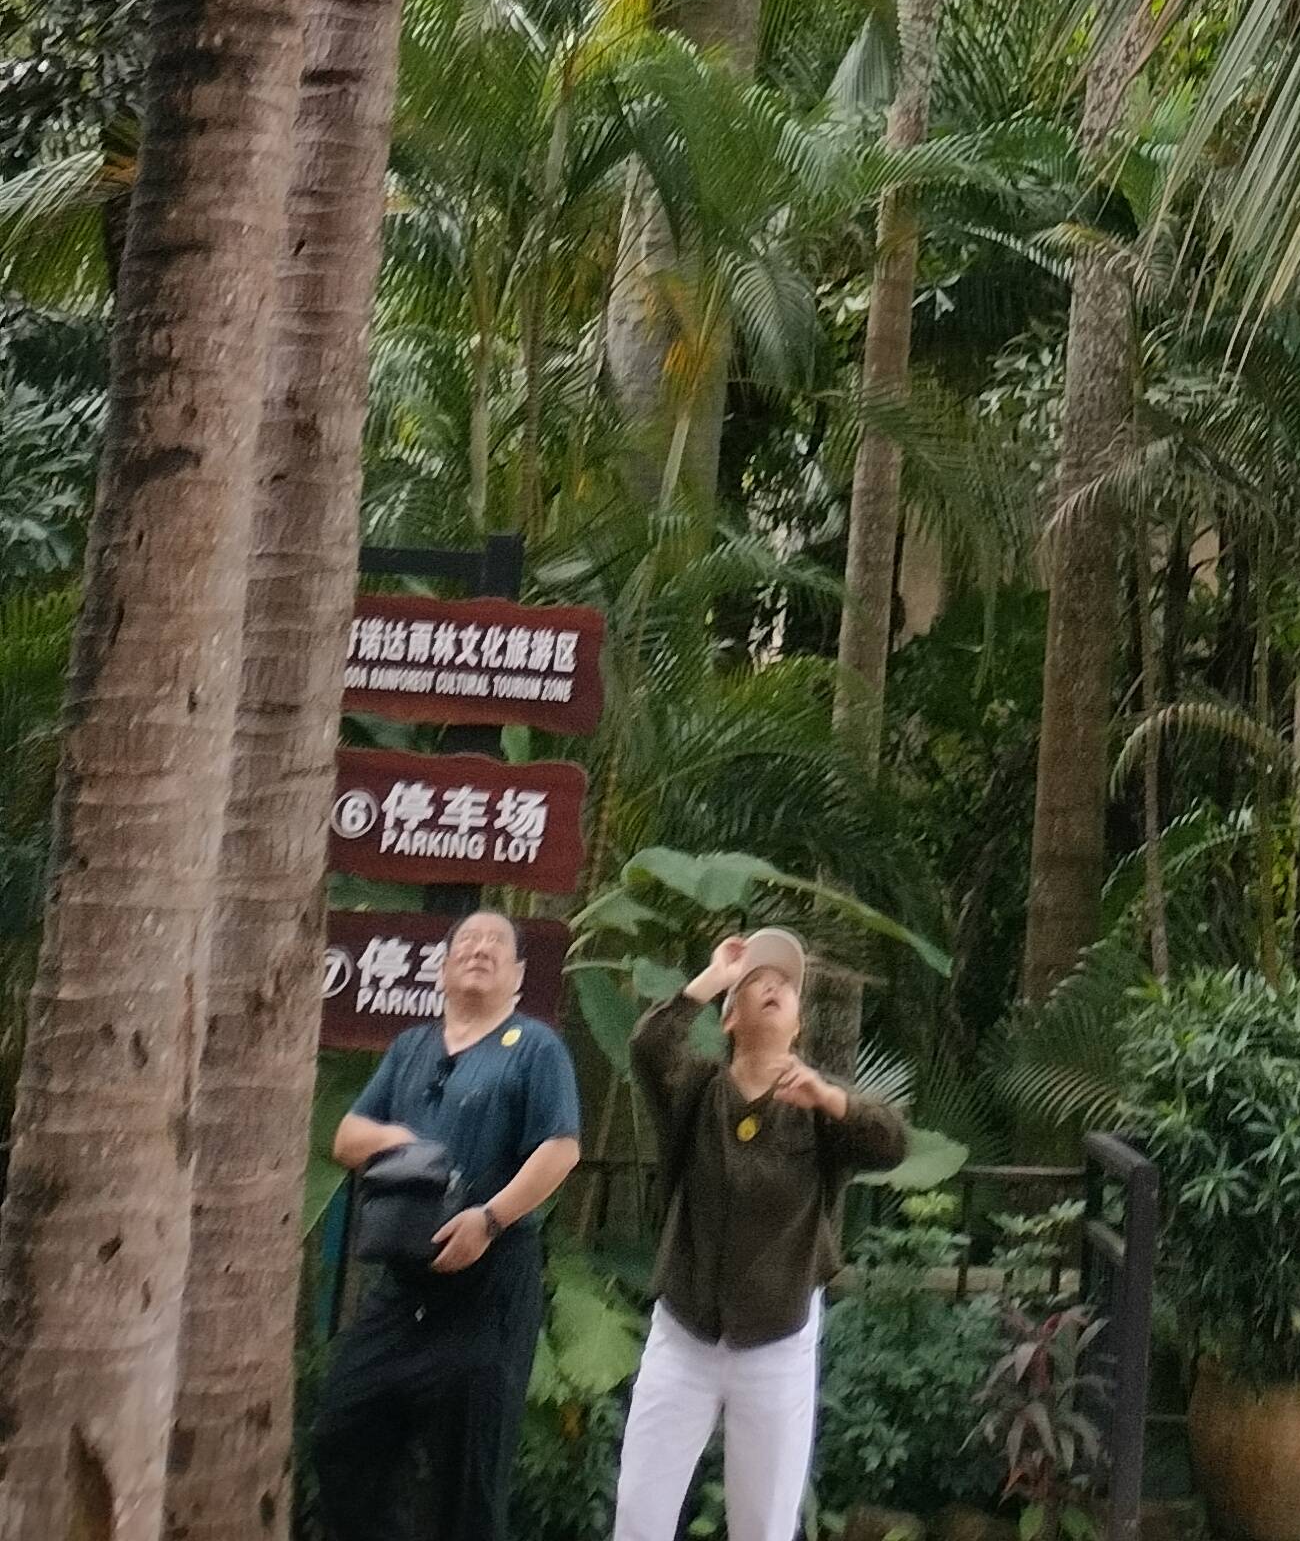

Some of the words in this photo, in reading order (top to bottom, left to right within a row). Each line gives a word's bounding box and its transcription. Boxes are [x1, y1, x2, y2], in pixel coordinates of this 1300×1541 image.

[368, 668, 436, 693] RAINFOREST
[435, 671, 491, 697] CULTURAL
[492, 675, 543, 701] TOURISM
[540, 678, 575, 703] ZONE
[381, 781, 549, 839] 停车场
[379, 829, 488, 861] PARKING
[493, 836, 543, 864] LOT
